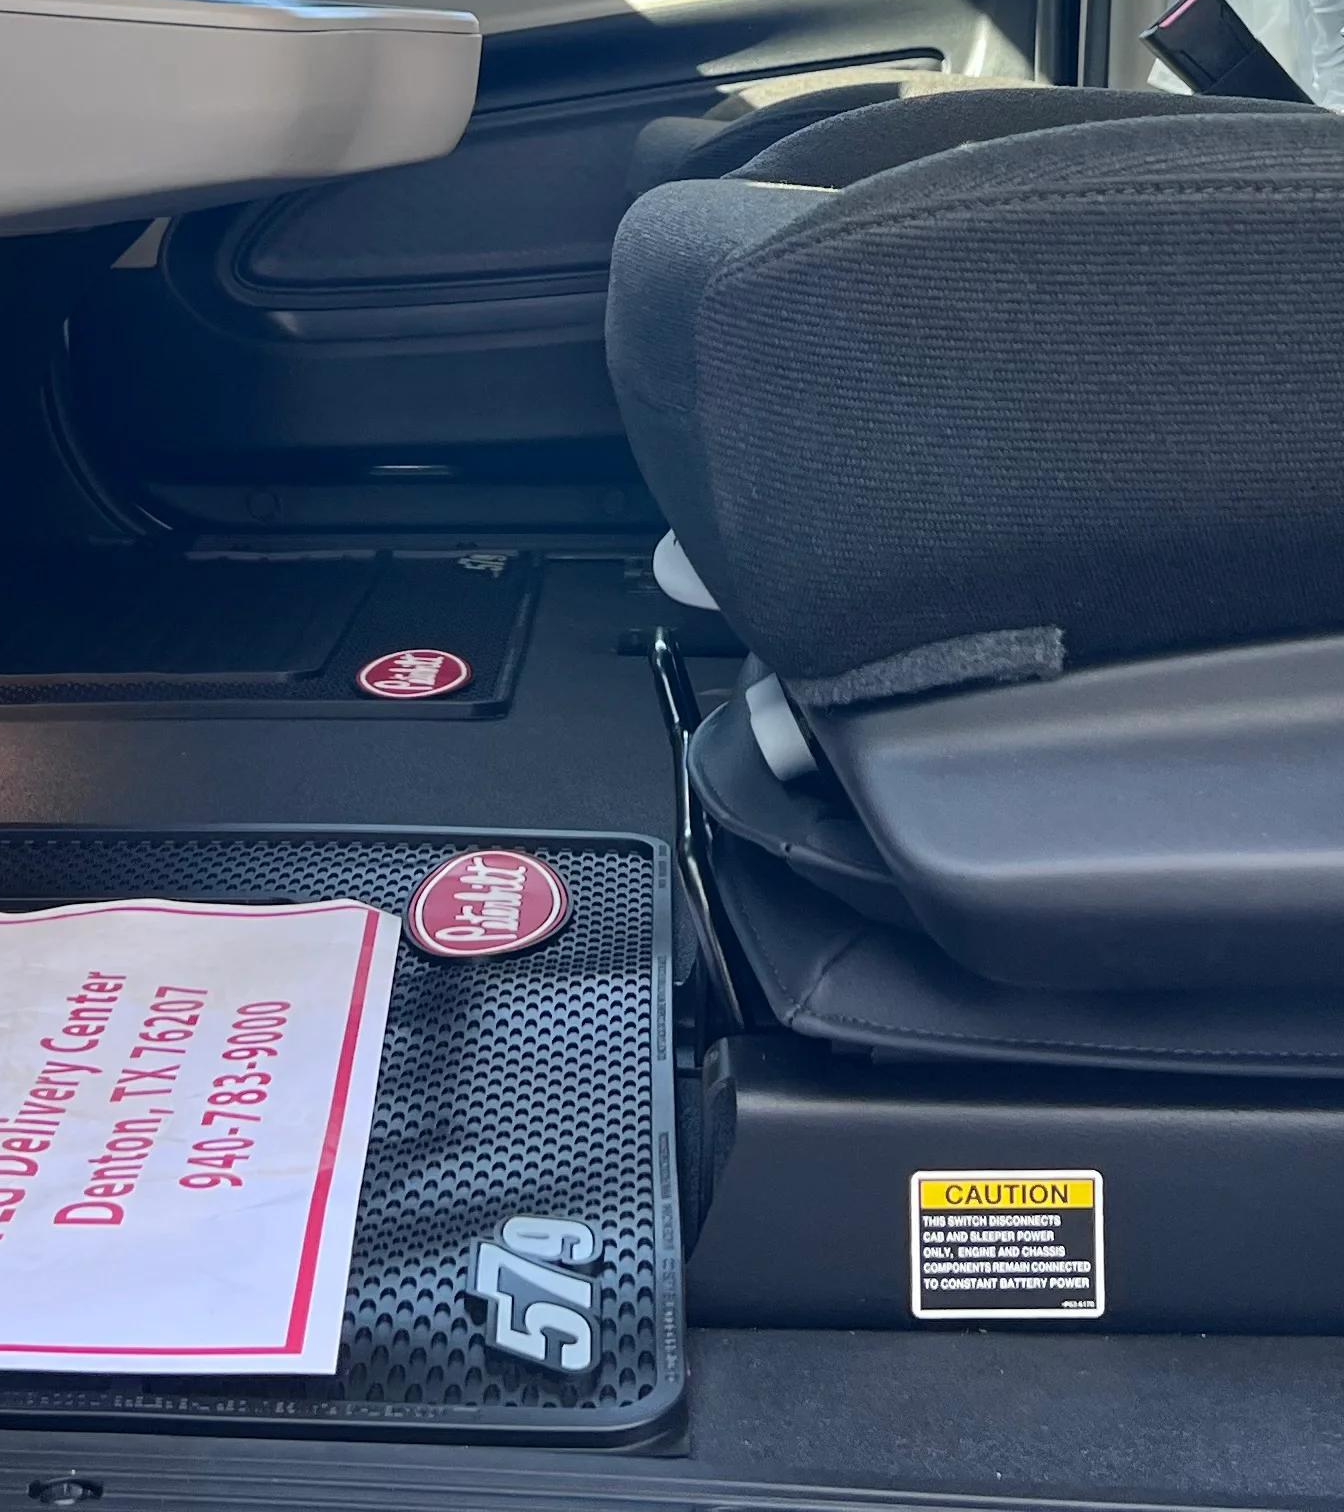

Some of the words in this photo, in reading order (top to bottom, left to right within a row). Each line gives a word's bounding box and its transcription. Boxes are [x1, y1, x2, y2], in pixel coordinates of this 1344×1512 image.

[434, 856, 527, 942] Peterbilt
[39, 971, 127, 1053] Center
[129, 986, 208, 1059] 76207
[109, 1064, 182, 1102] TX
[178, 1001, 291, 1189] 940-783-9000
[53, 1108, 174, 1226] Denton,
[945, 1184, 1069, 1205] CAUTION
[923, 1215, 946, 1227] THIS
[947, 1215, 987, 1227] SWITCH
[989, 1215, 1061, 1227] DISCONNECTS
[923, 1231, 944, 1243] CAB
[946, 1231, 968, 1242] AND
[970, 1231, 1015, 1242] SLEEPER
[1017, 1230, 1055, 1242] POWER
[923, 1246, 954, 1259] ONLY,
[958, 1246, 996, 1258] ENGINE
[998, 1246, 1020, 1257] AND
[1021, 1245, 1066, 1257] CHASSIS
[923, 1262, 991, 1274] COMPONENTS
[993, 1261, 1030, 1273] REMAIN
[1031, 1261, 1091, 1273] CONNECTED
[477, 1216, 594, 1370] 579
[923, 1277, 939, 1290] TO
[941, 1277, 998, 1290] CONSTANT
[999, 1277, 1048, 1289] BATTERY
[1049, 1277, 1090, 1289] POWER
